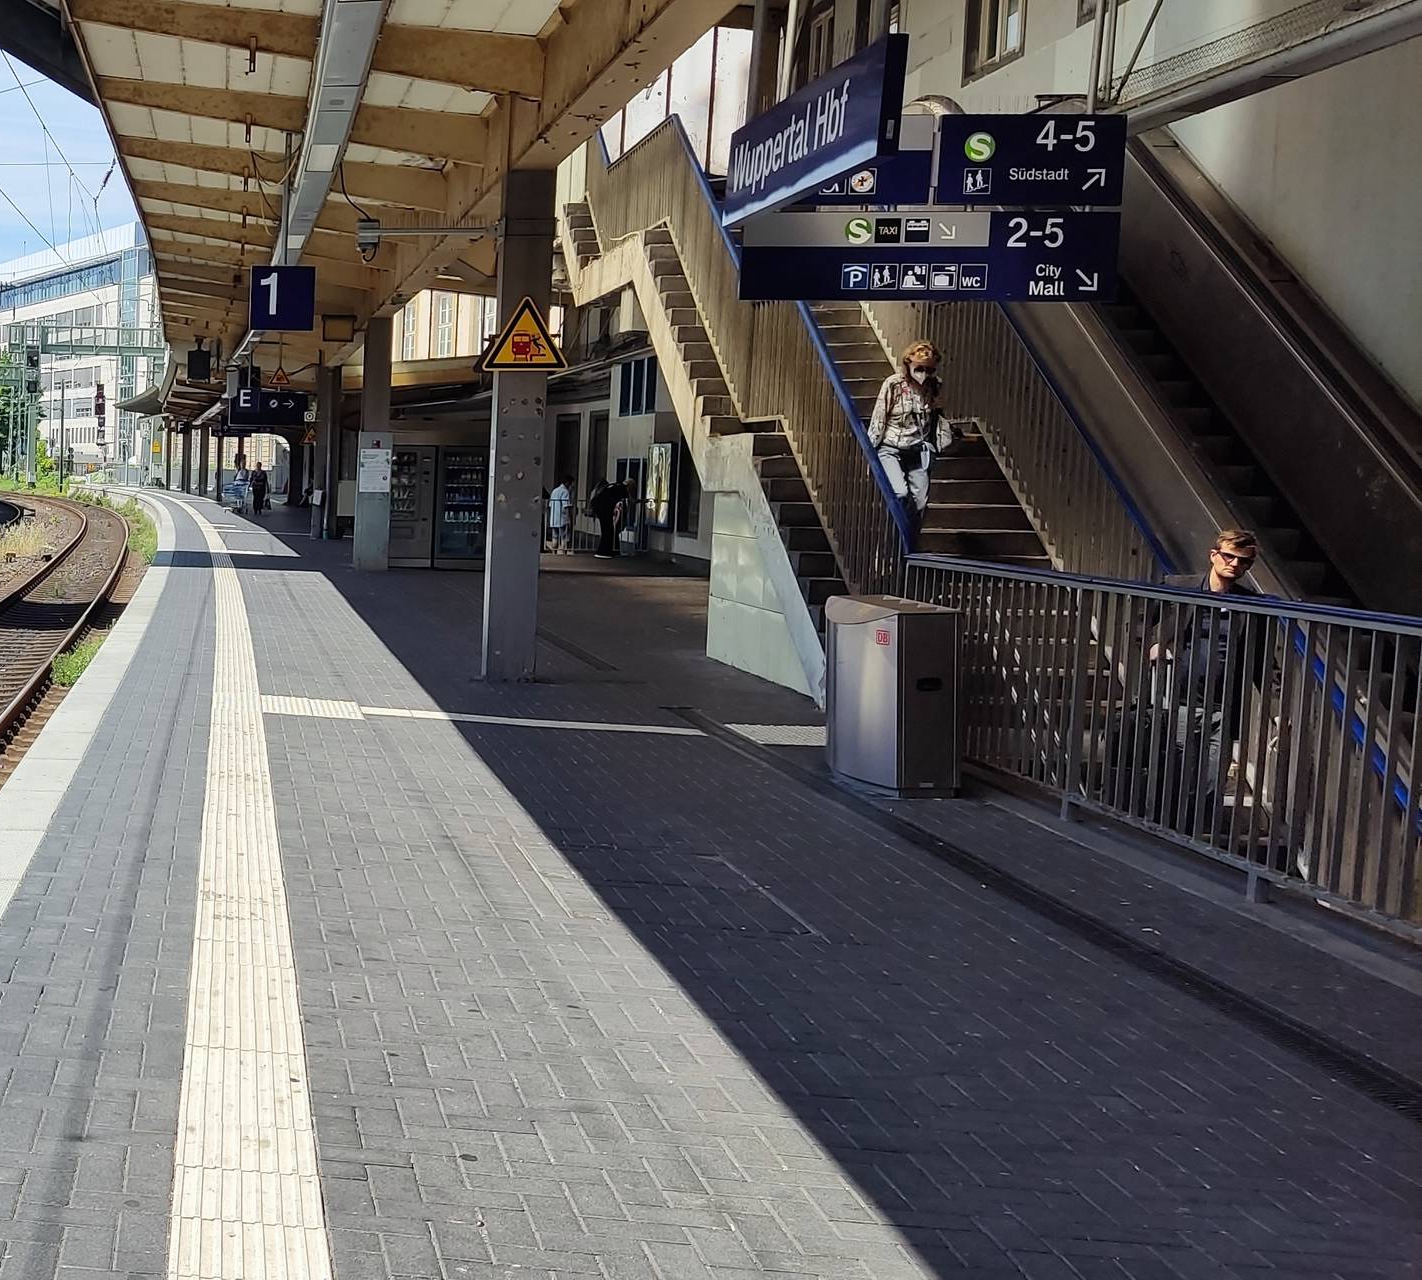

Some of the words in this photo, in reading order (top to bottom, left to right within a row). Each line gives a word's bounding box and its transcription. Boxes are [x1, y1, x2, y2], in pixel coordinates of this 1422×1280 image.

[732, 102, 811, 195] Wuppertal
[813, 78, 851, 151] Hbf
[1036, 119, 1096, 152] 4-5
[966, 131, 995, 161] S
[1009, 167, 1070, 181] Südstadt
[846, 218, 872, 244] S
[878, 226, 898, 235] TAXI
[1006, 217, 1065, 248] 2-5
[849, 271, 863, 287] P
[961, 276, 981, 288] WC
[1035, 263, 1062, 279] City
[260, 272, 278, 316] 1
[1028, 280, 1065, 296] Mall
[239, 389, 252, 408] E
[178, 421, 185, 432] F
[877, 631, 889, 644] DB
